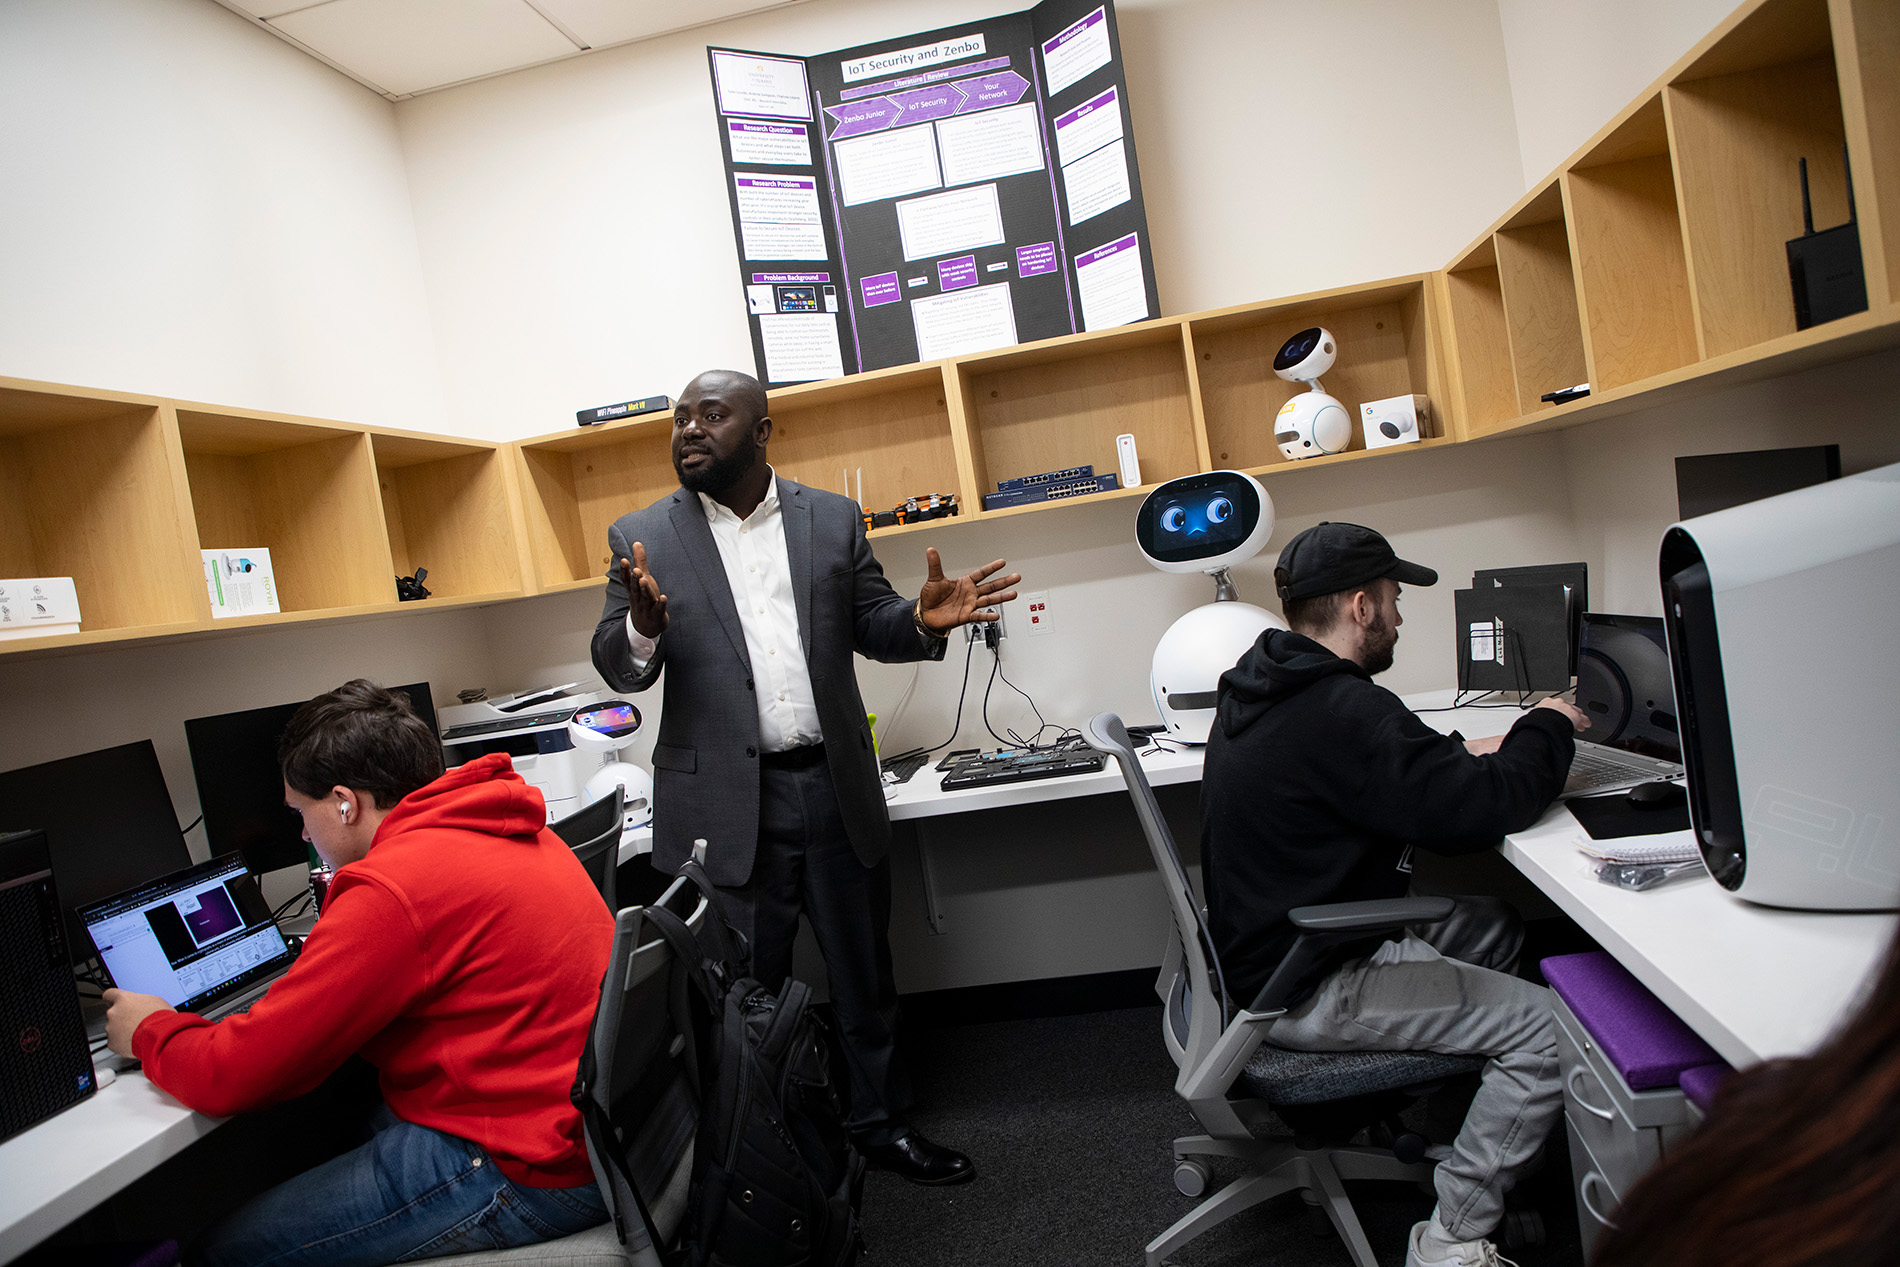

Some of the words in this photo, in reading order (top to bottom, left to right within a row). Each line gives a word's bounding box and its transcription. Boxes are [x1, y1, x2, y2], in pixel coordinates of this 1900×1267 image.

[1060, 23, 1087, 44] Methodology
[848, 63, 866, 74] IoT
[868, 53, 914, 71] Security
[917, 47, 938, 60] and
[944, 41, 980, 55] Zenbo
[894, 76, 922, 86] Literature
[927, 71, 949, 80] Review
[984, 82, 1000, 90] Your
[979, 90, 1008, 100] Network
[920, 97, 947, 109] Security
[844, 114, 864, 124] Zenbo
[865, 110, 886, 120] Junior
[1078, 105, 1093, 117] Results
[1094, 246, 1117, 259] References
[606, 405, 627, 416] Pineapple
[628, 402, 638, 411] Mark
[263, 576, 274, 605] ROYBI
